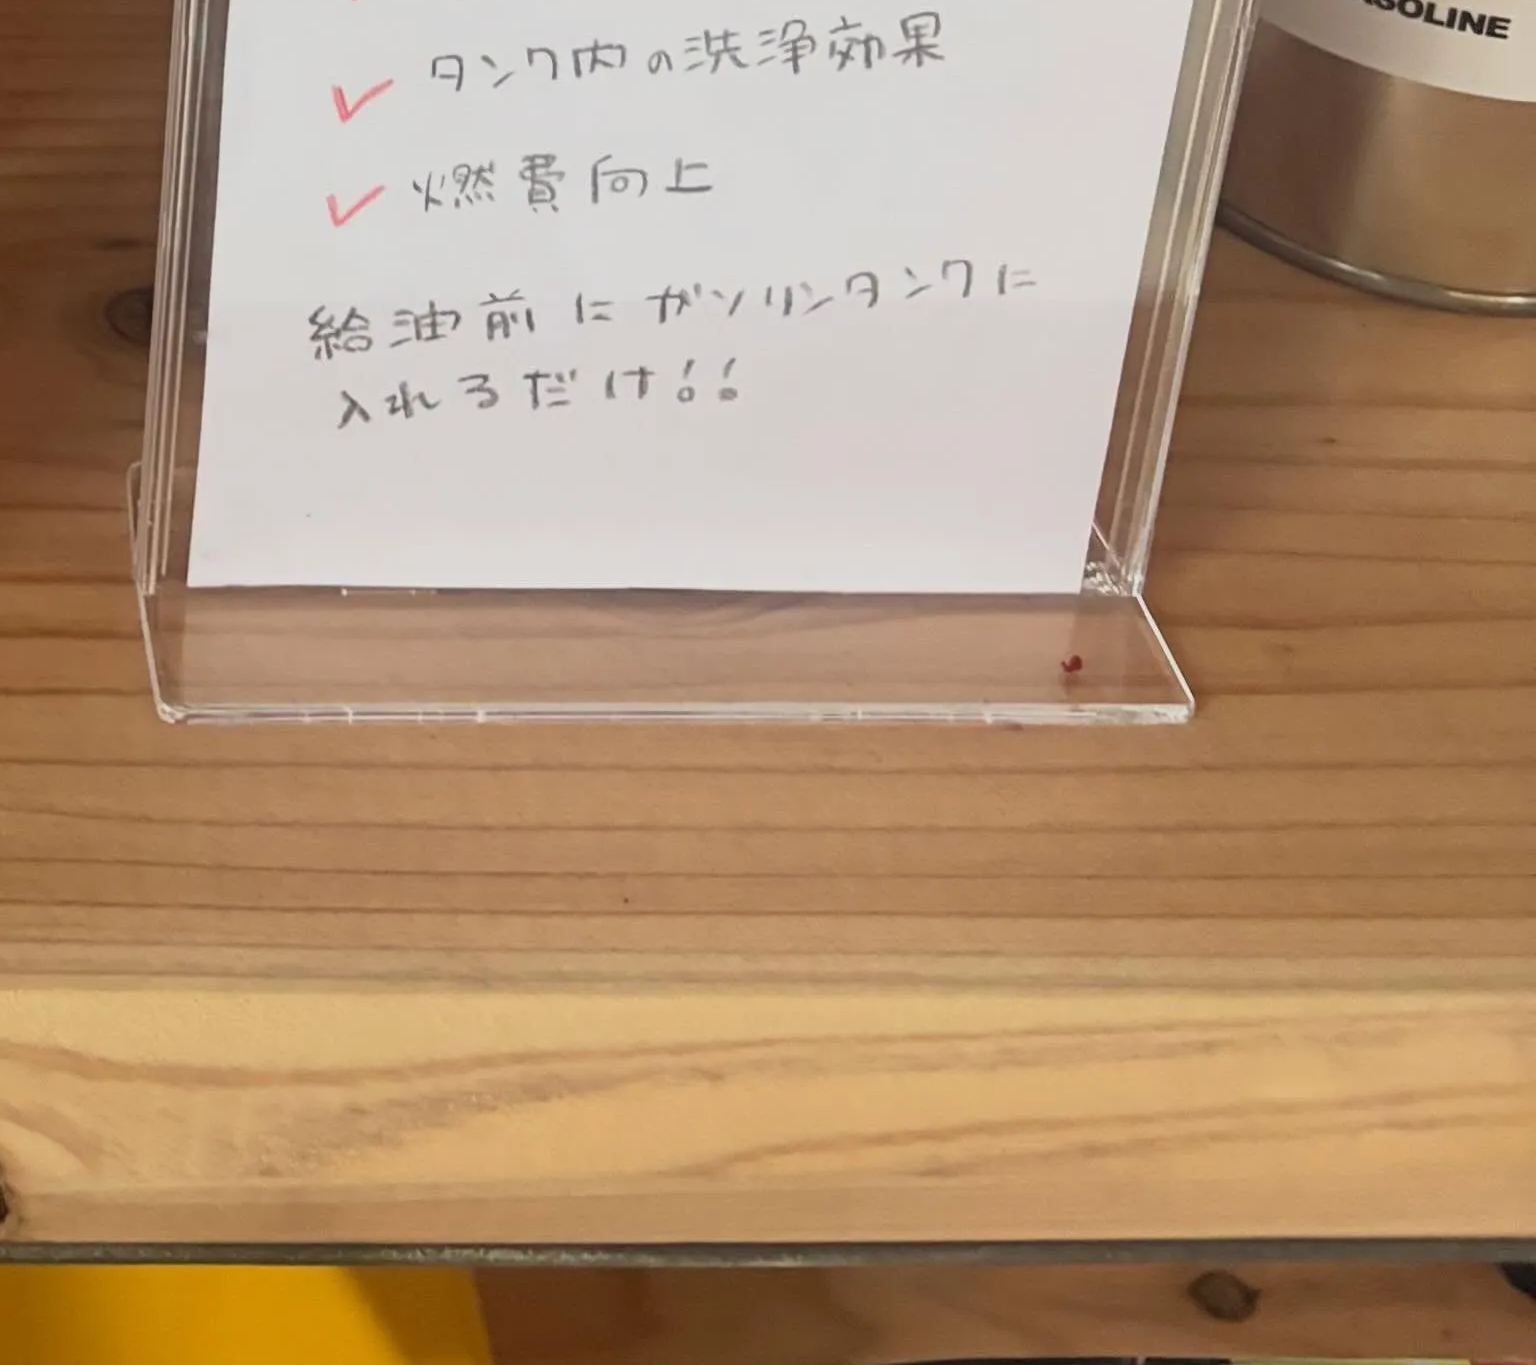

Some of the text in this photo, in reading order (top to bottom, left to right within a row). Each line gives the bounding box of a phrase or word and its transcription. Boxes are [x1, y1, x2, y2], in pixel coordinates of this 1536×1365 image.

[430, 11, 947, 93] タンク内の洗浄効果
[411, 152, 714, 214] 燃費向上
